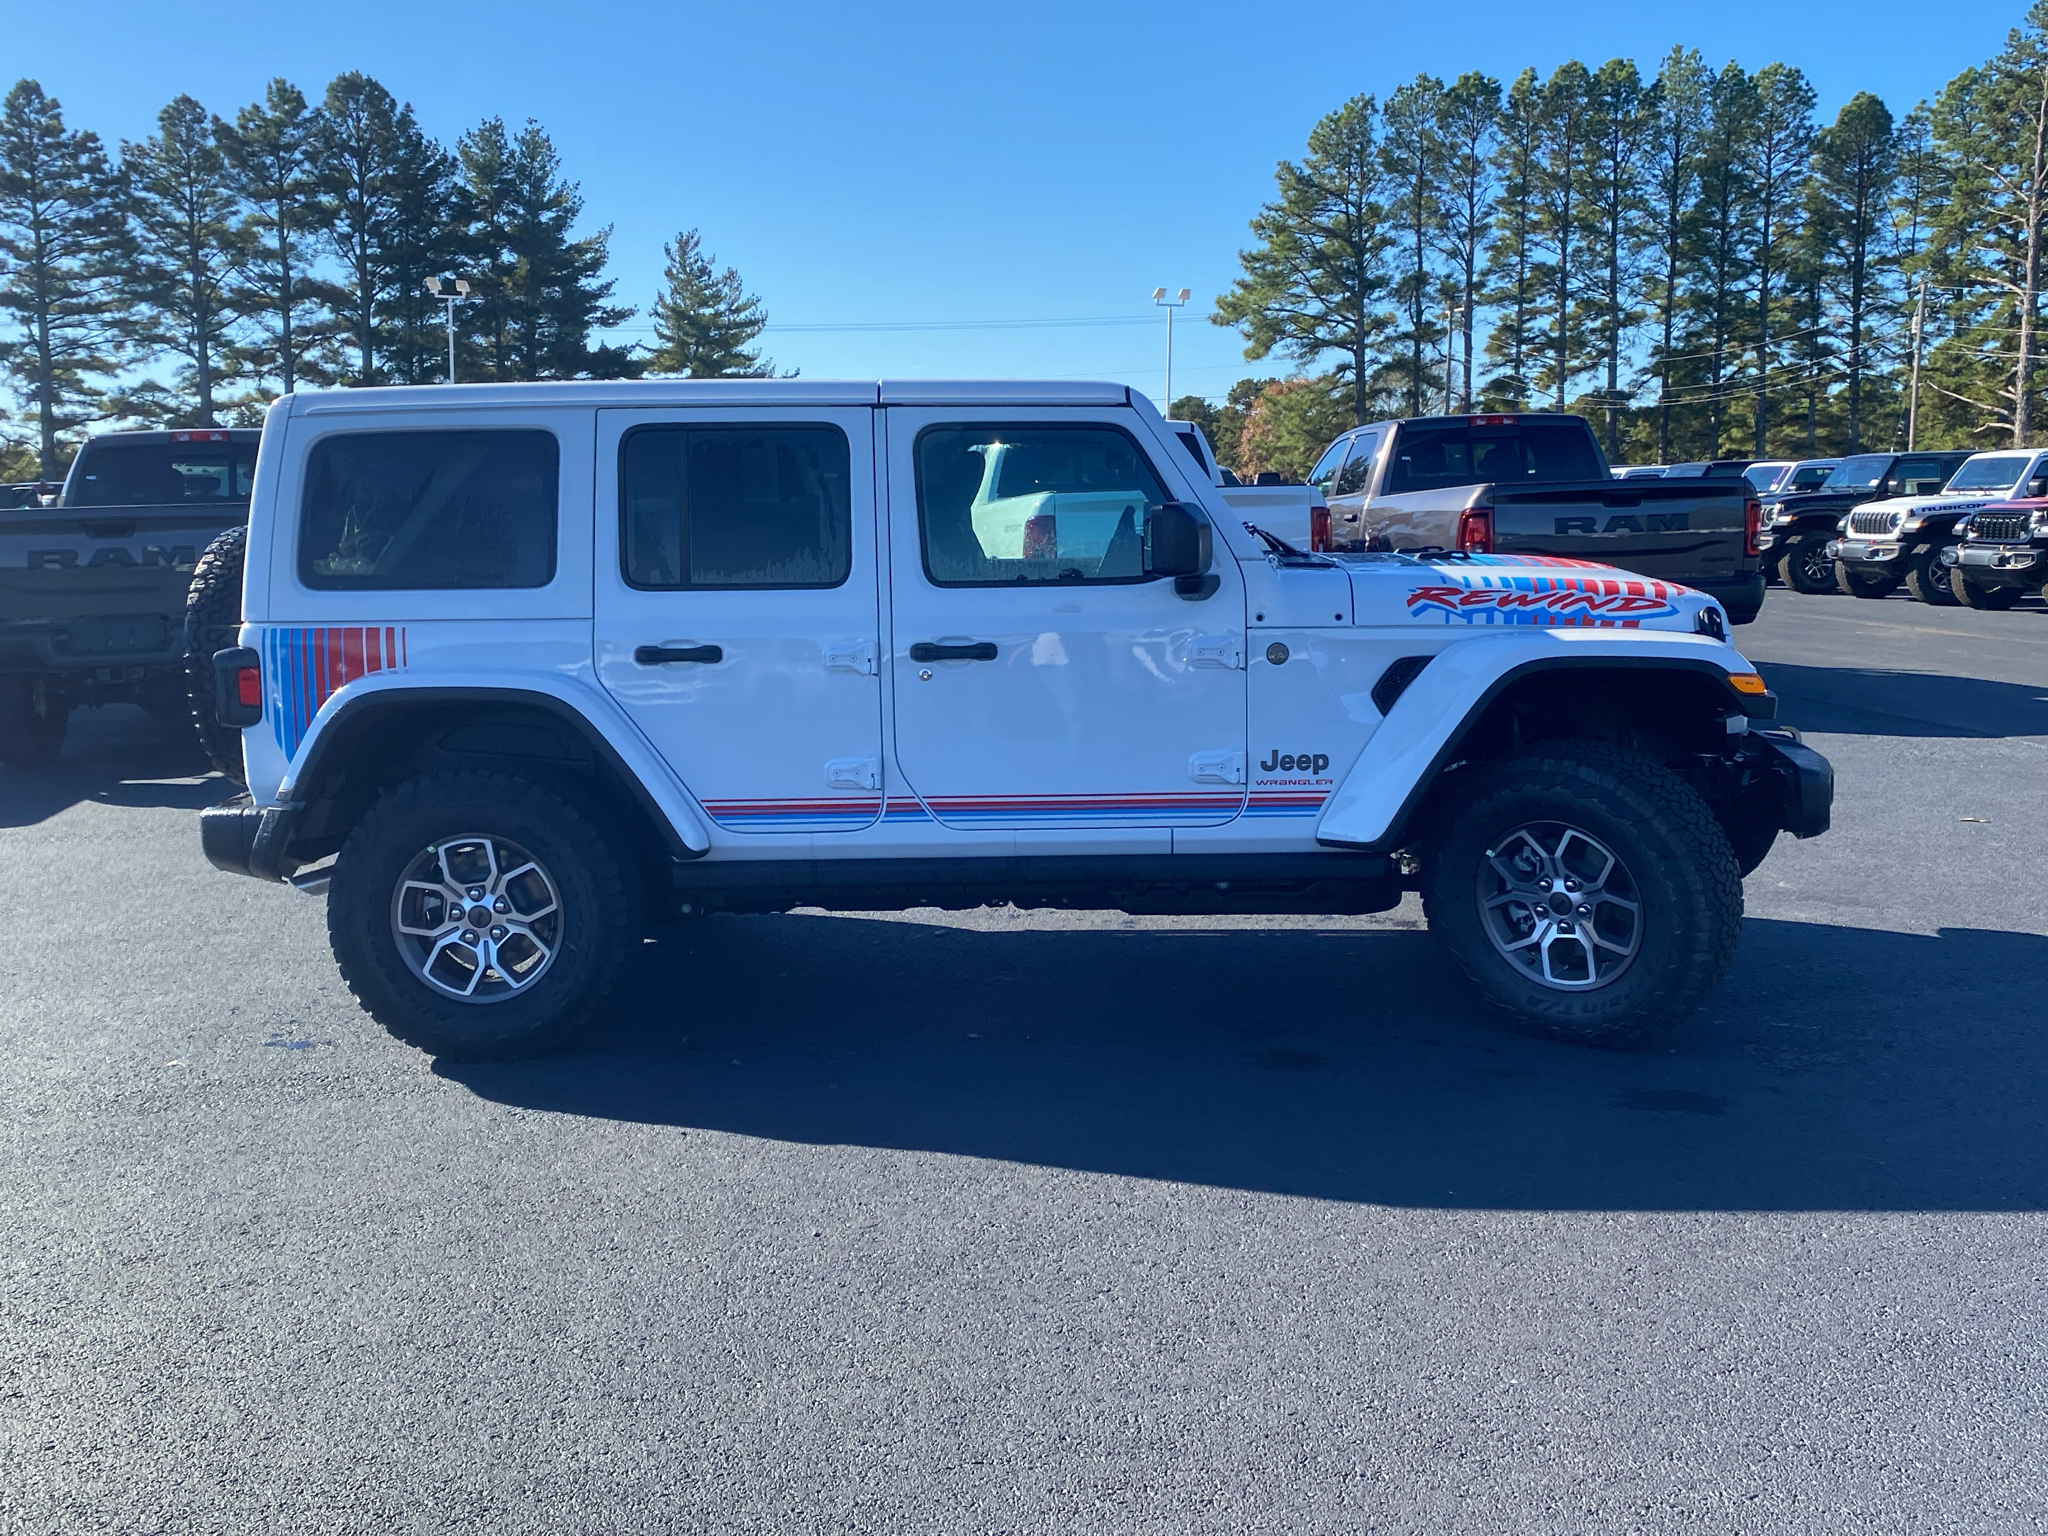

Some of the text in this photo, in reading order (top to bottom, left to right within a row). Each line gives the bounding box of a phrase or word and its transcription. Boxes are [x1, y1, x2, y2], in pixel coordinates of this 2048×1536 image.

[1921, 503, 1987, 512] RUBICON
[1554, 513, 1690, 534] RAM
[27, 545, 195, 568] RAM
[1407, 586, 1668, 612] REWIND
[1260, 749, 1329, 775] Jeep
